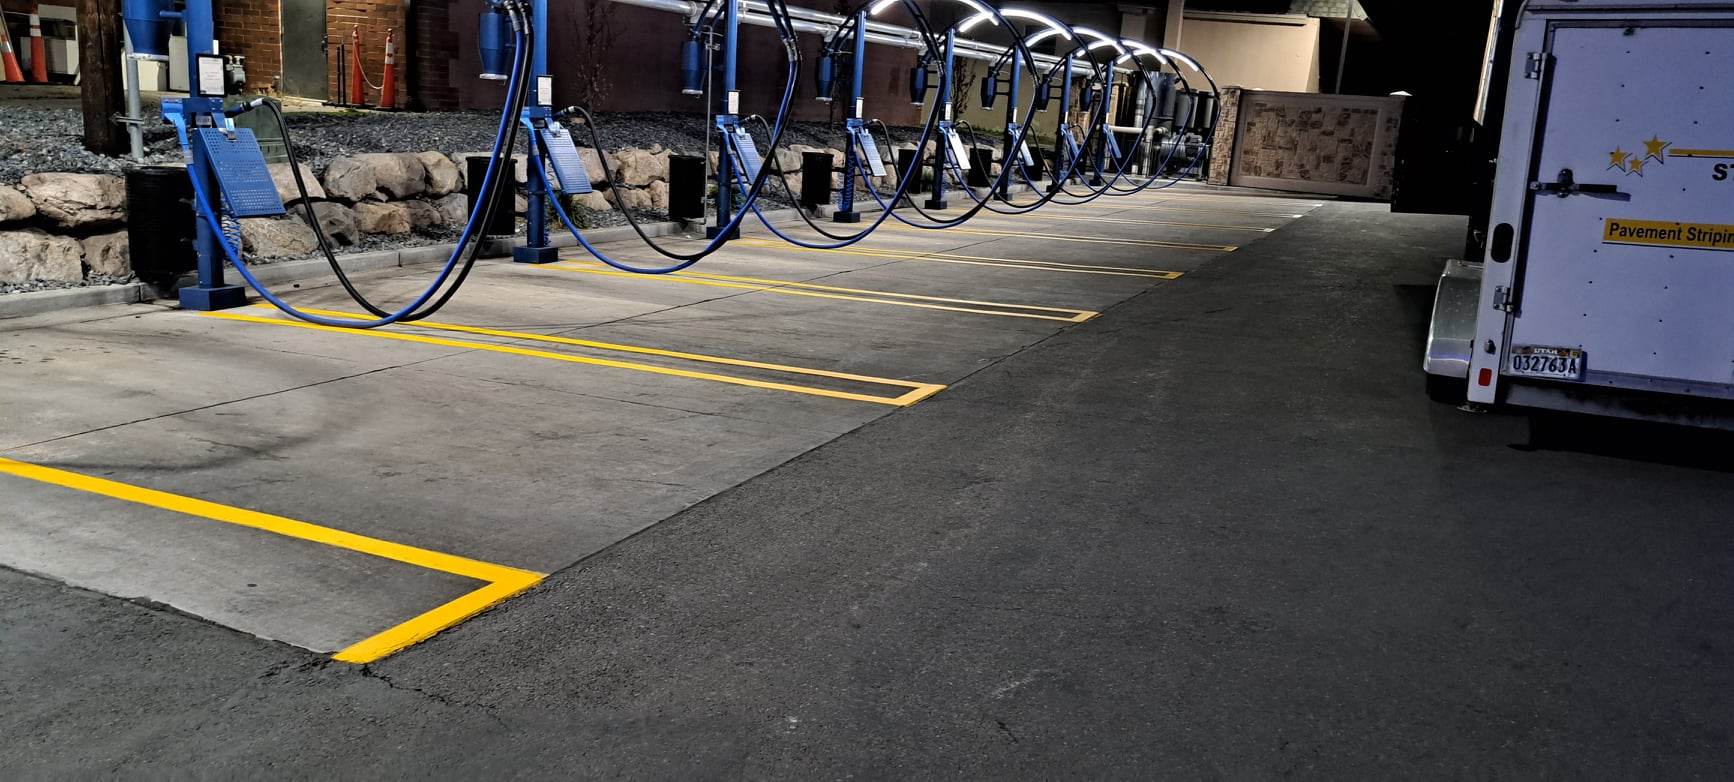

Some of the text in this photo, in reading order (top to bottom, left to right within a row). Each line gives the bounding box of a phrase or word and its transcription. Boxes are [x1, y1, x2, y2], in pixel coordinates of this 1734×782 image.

[1712, 163, 1734, 181] S
[1609, 222, 1683, 241] Pavement
[1513, 355, 1577, 374] 032763A
